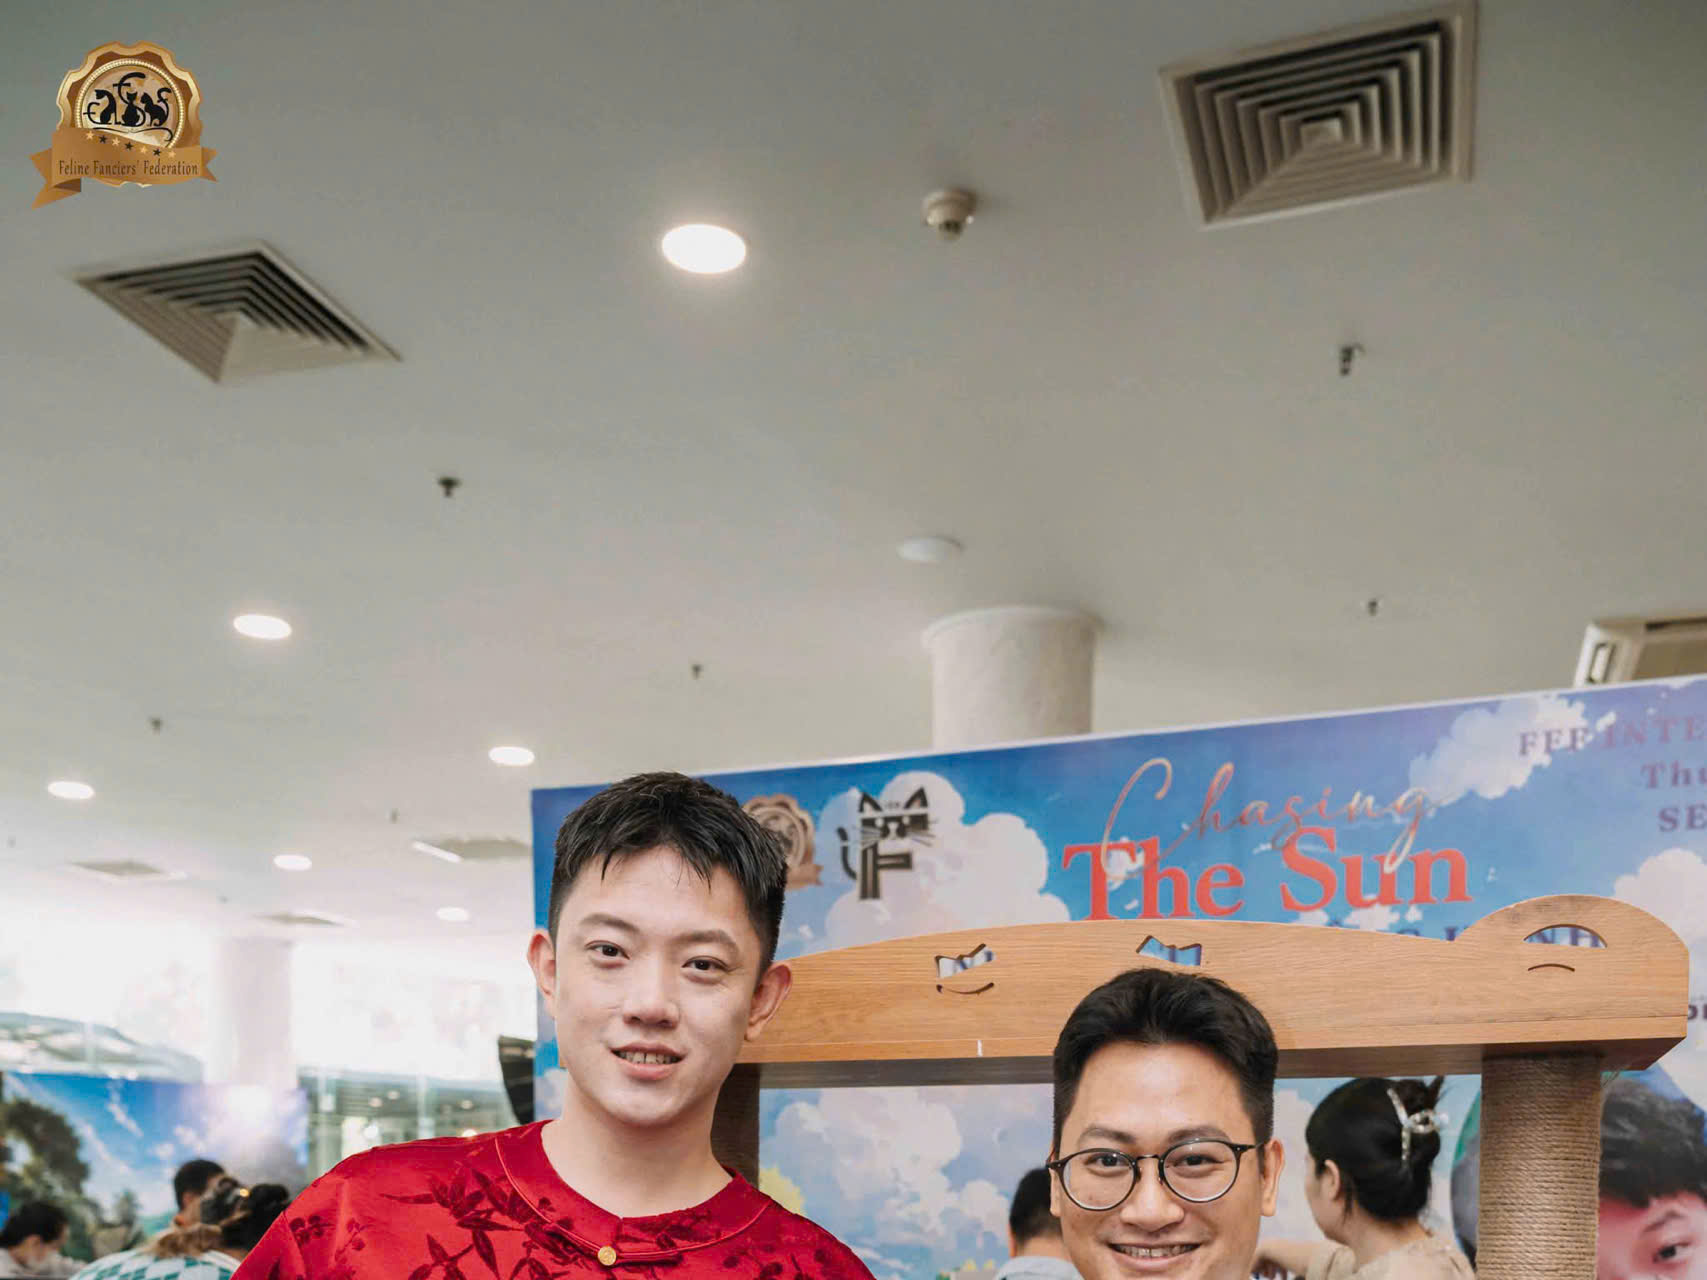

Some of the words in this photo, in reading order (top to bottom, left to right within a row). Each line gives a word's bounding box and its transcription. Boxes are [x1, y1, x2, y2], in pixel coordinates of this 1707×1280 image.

[1100, 757, 1430, 880] Chasing
[1062, 835, 1245, 920] The
[1279, 826, 1474, 913] Sun
